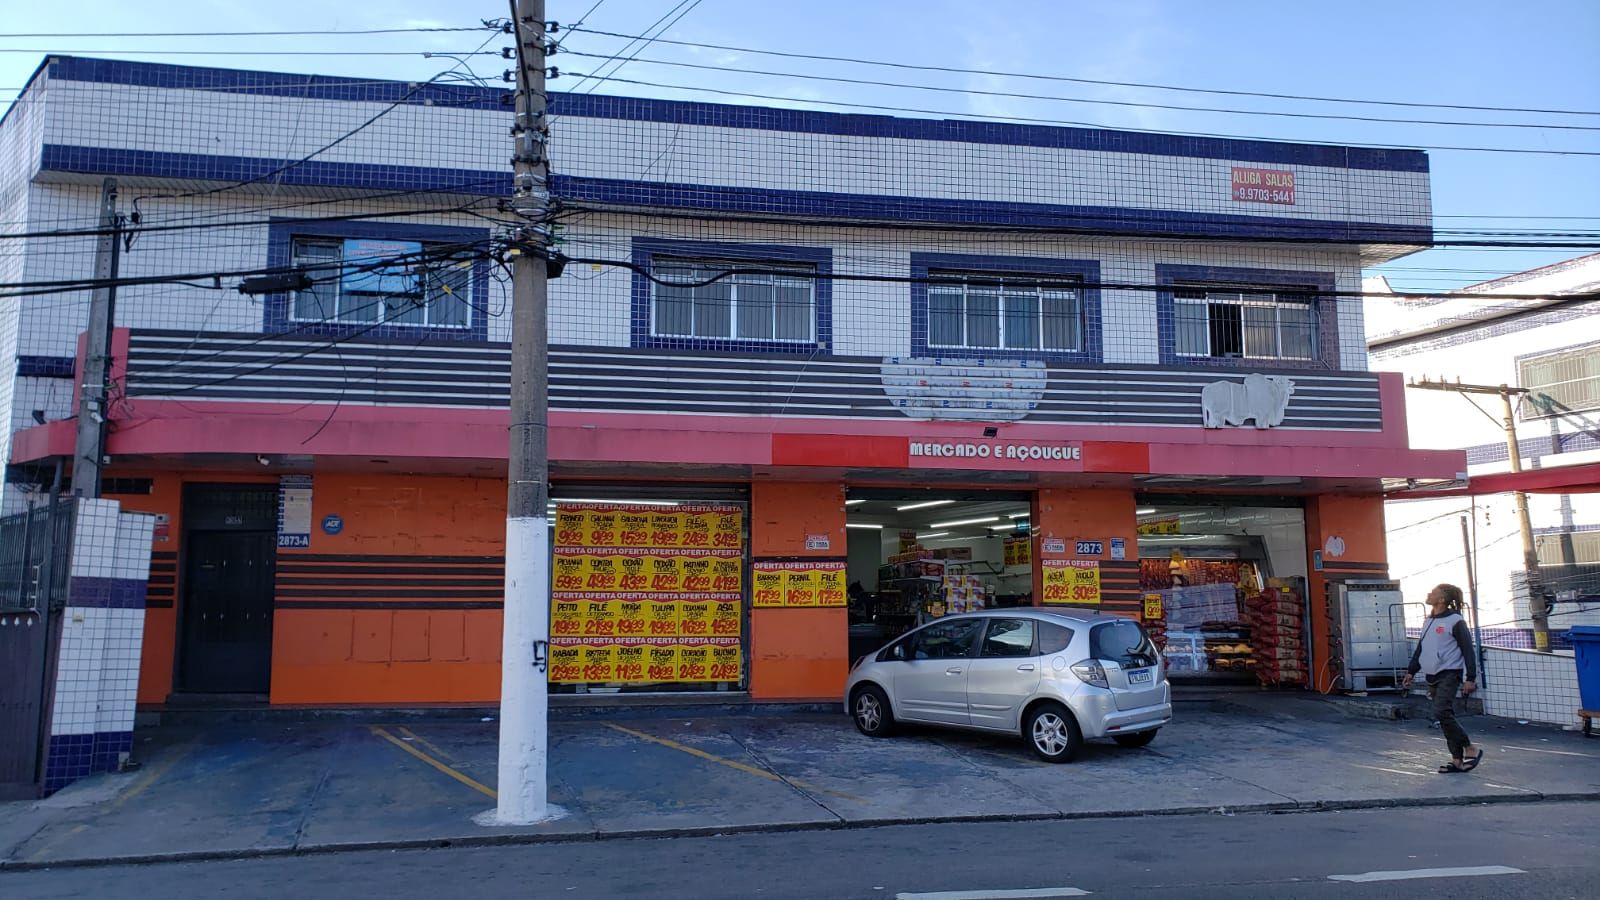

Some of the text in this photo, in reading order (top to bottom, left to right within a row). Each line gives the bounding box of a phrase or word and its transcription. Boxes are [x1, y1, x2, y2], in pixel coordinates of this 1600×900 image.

[1233, 171, 1293, 187] ALUGA SALAS
[1240, 187, 1294, 203] 9.9703-5441
[910, 442, 1080, 461] MERCADO E AÇOUGUE
[279, 536, 309, 546] 2873-A
[1077, 543, 1102, 553] 2873
